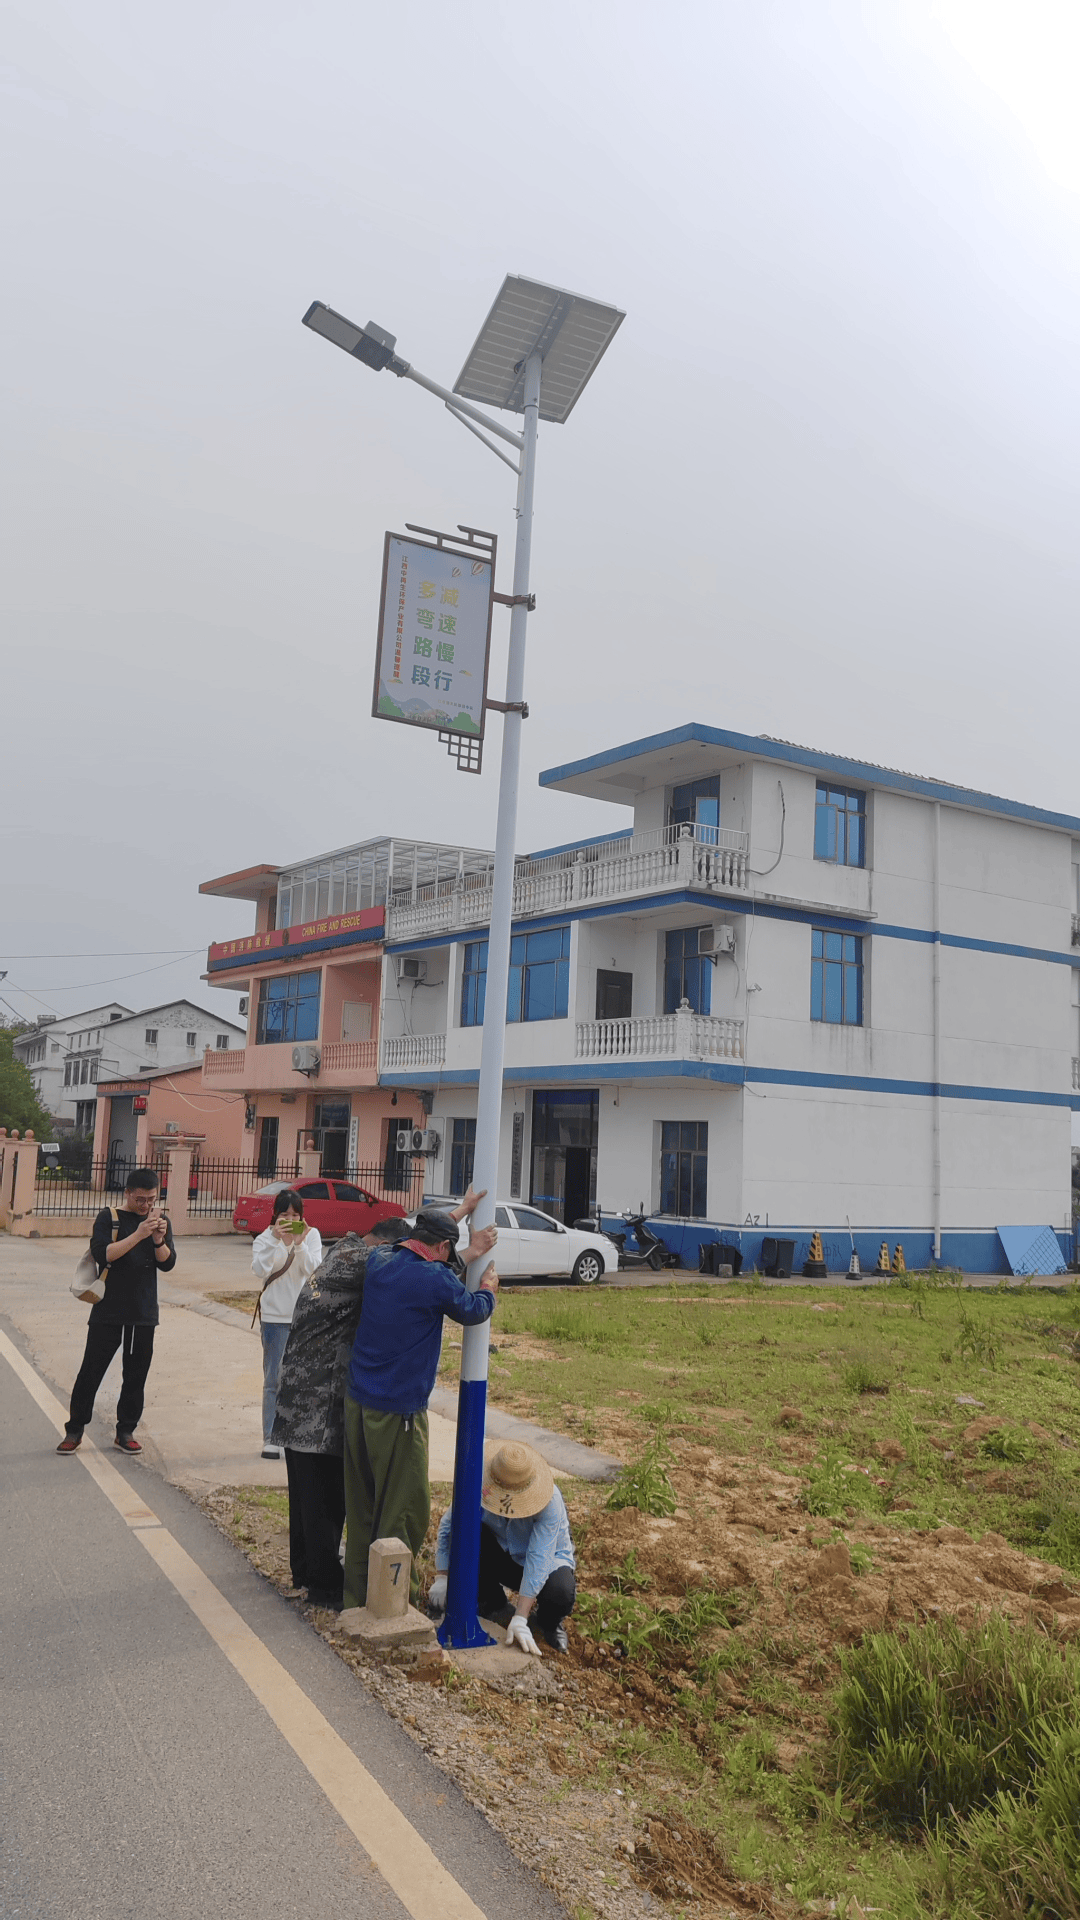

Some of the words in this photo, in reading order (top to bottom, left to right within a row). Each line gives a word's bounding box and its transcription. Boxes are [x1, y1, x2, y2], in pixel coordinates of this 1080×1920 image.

[411, 579, 437, 688] 多弯路段
[433, 585, 459, 692] 减速慢行
[302, 926, 316, 938] CHINA
[316, 922, 328, 935] FIRE
[329, 919, 340, 931] AND
[341, 914, 361, 929] RESCUE
[389, 1562, 402, 1586] 7
